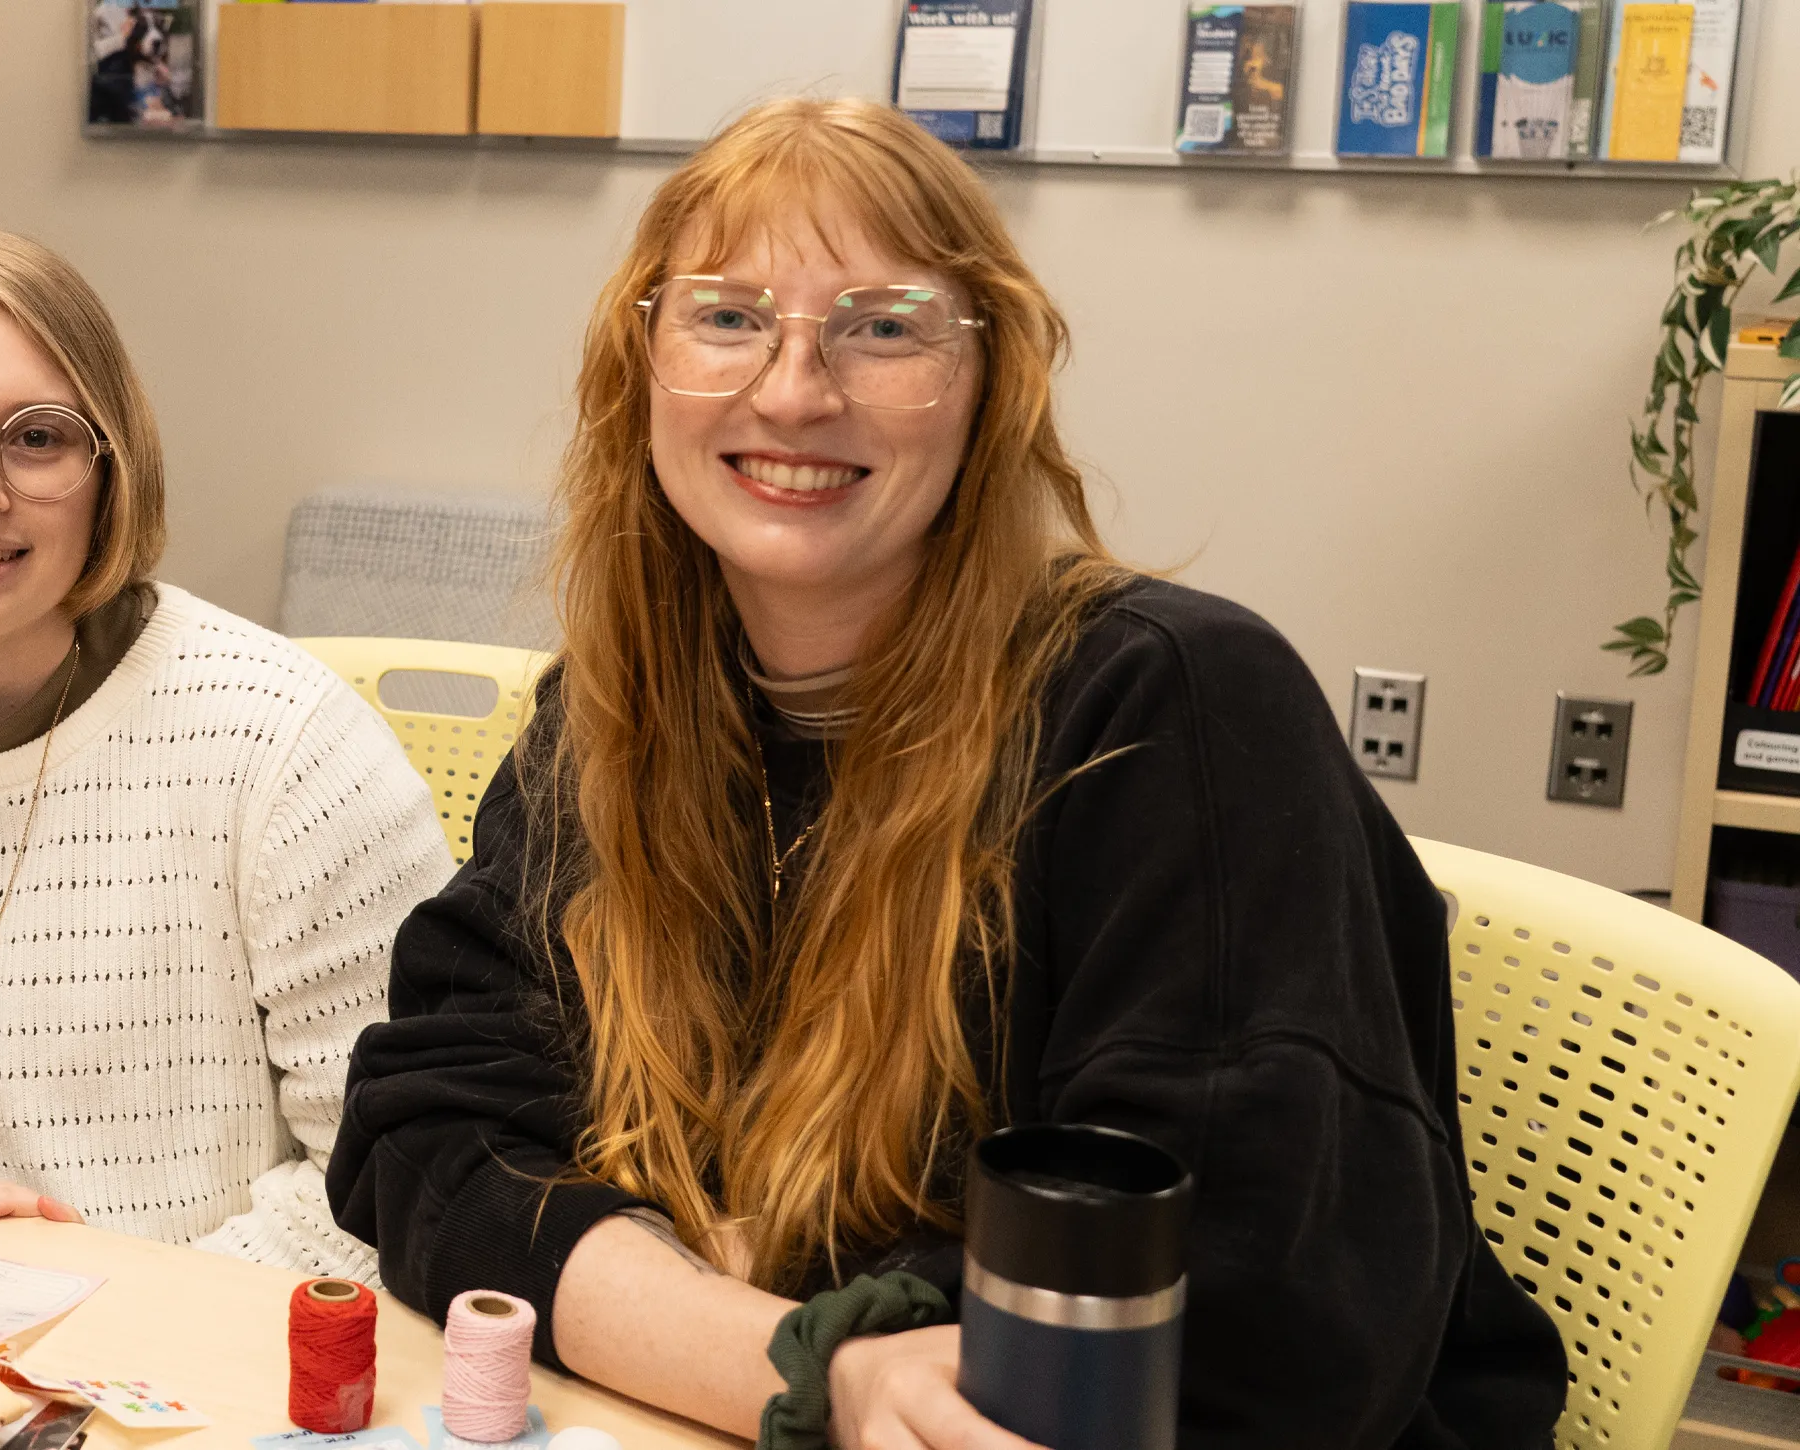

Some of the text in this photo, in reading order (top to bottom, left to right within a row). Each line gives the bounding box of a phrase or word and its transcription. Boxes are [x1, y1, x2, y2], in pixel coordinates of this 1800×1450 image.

[908, 10, 1018, 25] Work with us!
[1746, 739, 1798, 753] Colouring
